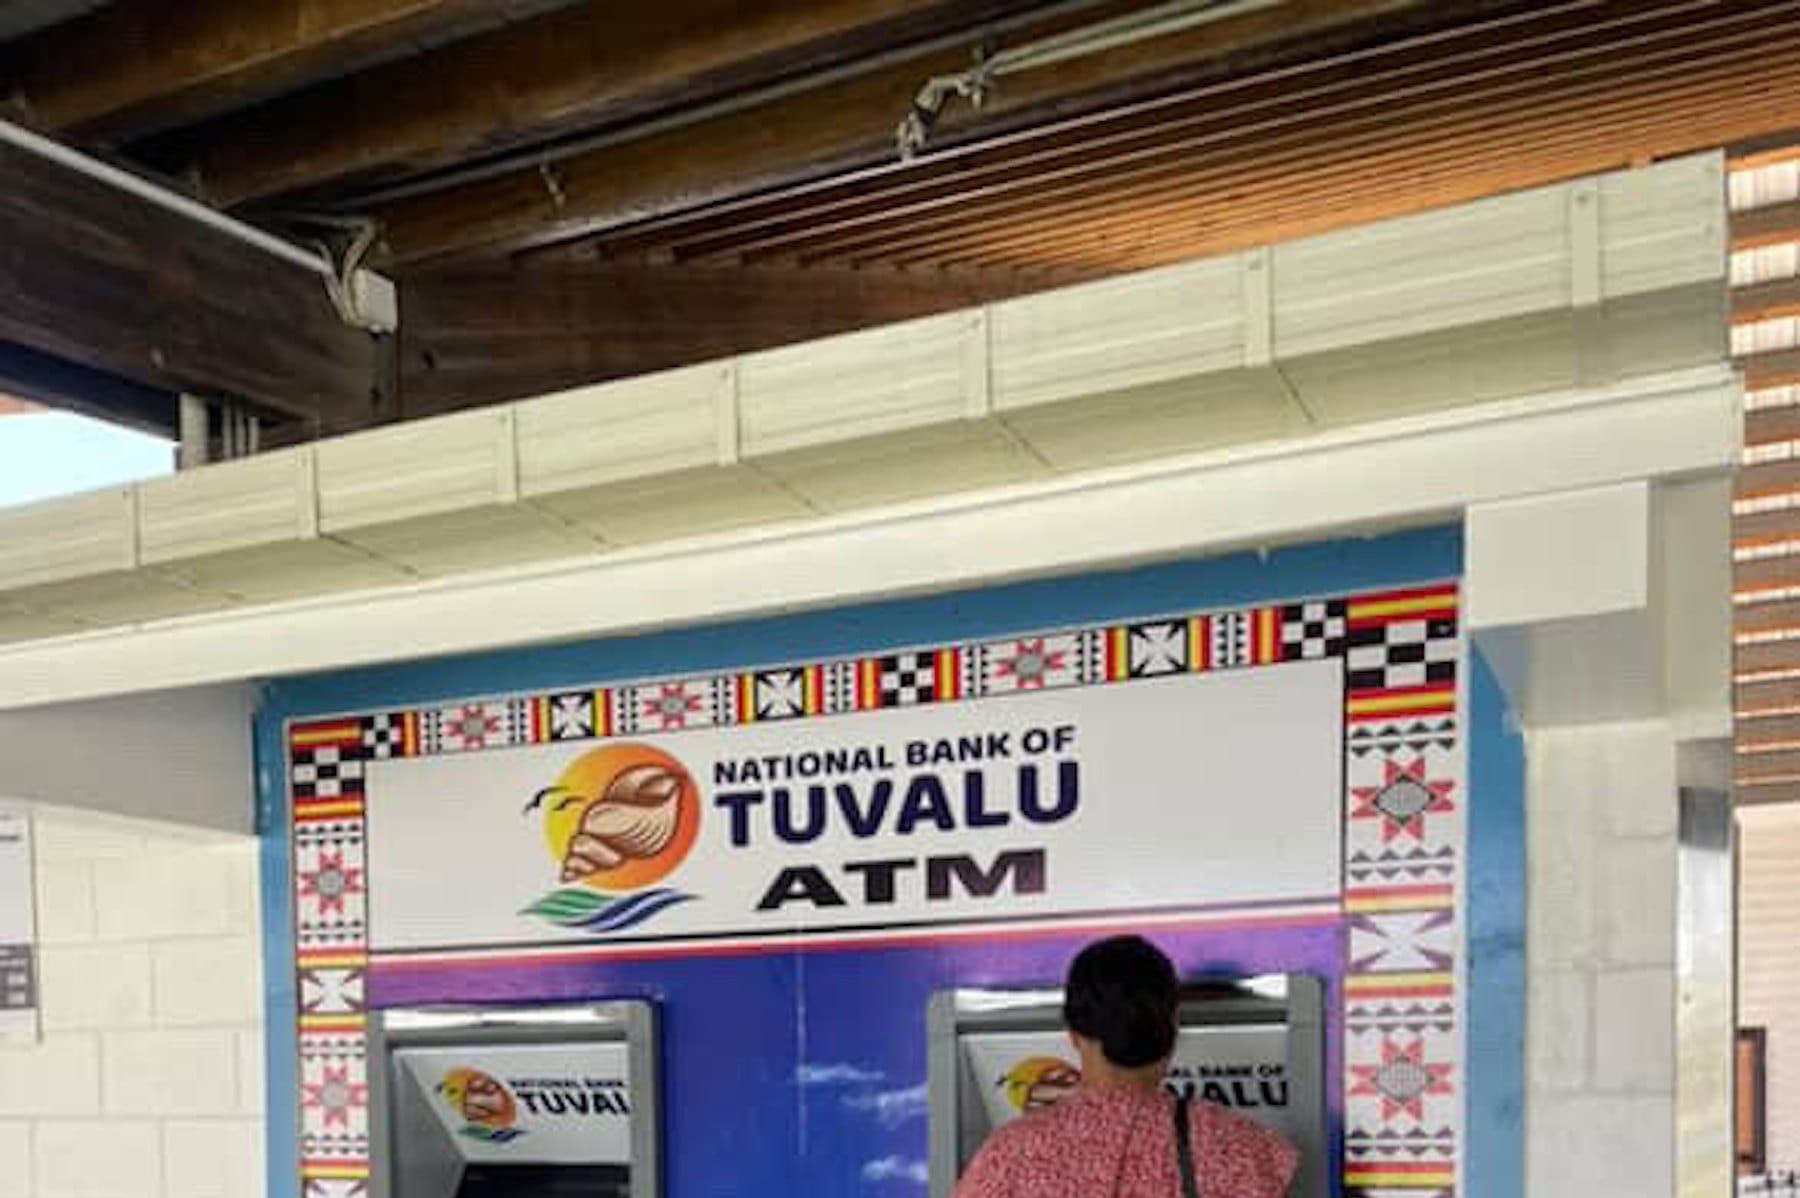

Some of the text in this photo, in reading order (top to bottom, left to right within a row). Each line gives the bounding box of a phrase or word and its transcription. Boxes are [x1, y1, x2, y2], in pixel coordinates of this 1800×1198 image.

[714, 725, 1077, 784] NATIONAL BANK OF
[714, 760, 1080, 847] TUVALU
[756, 848, 1046, 911] ATM
[1165, 1081, 1288, 1106] VALU
